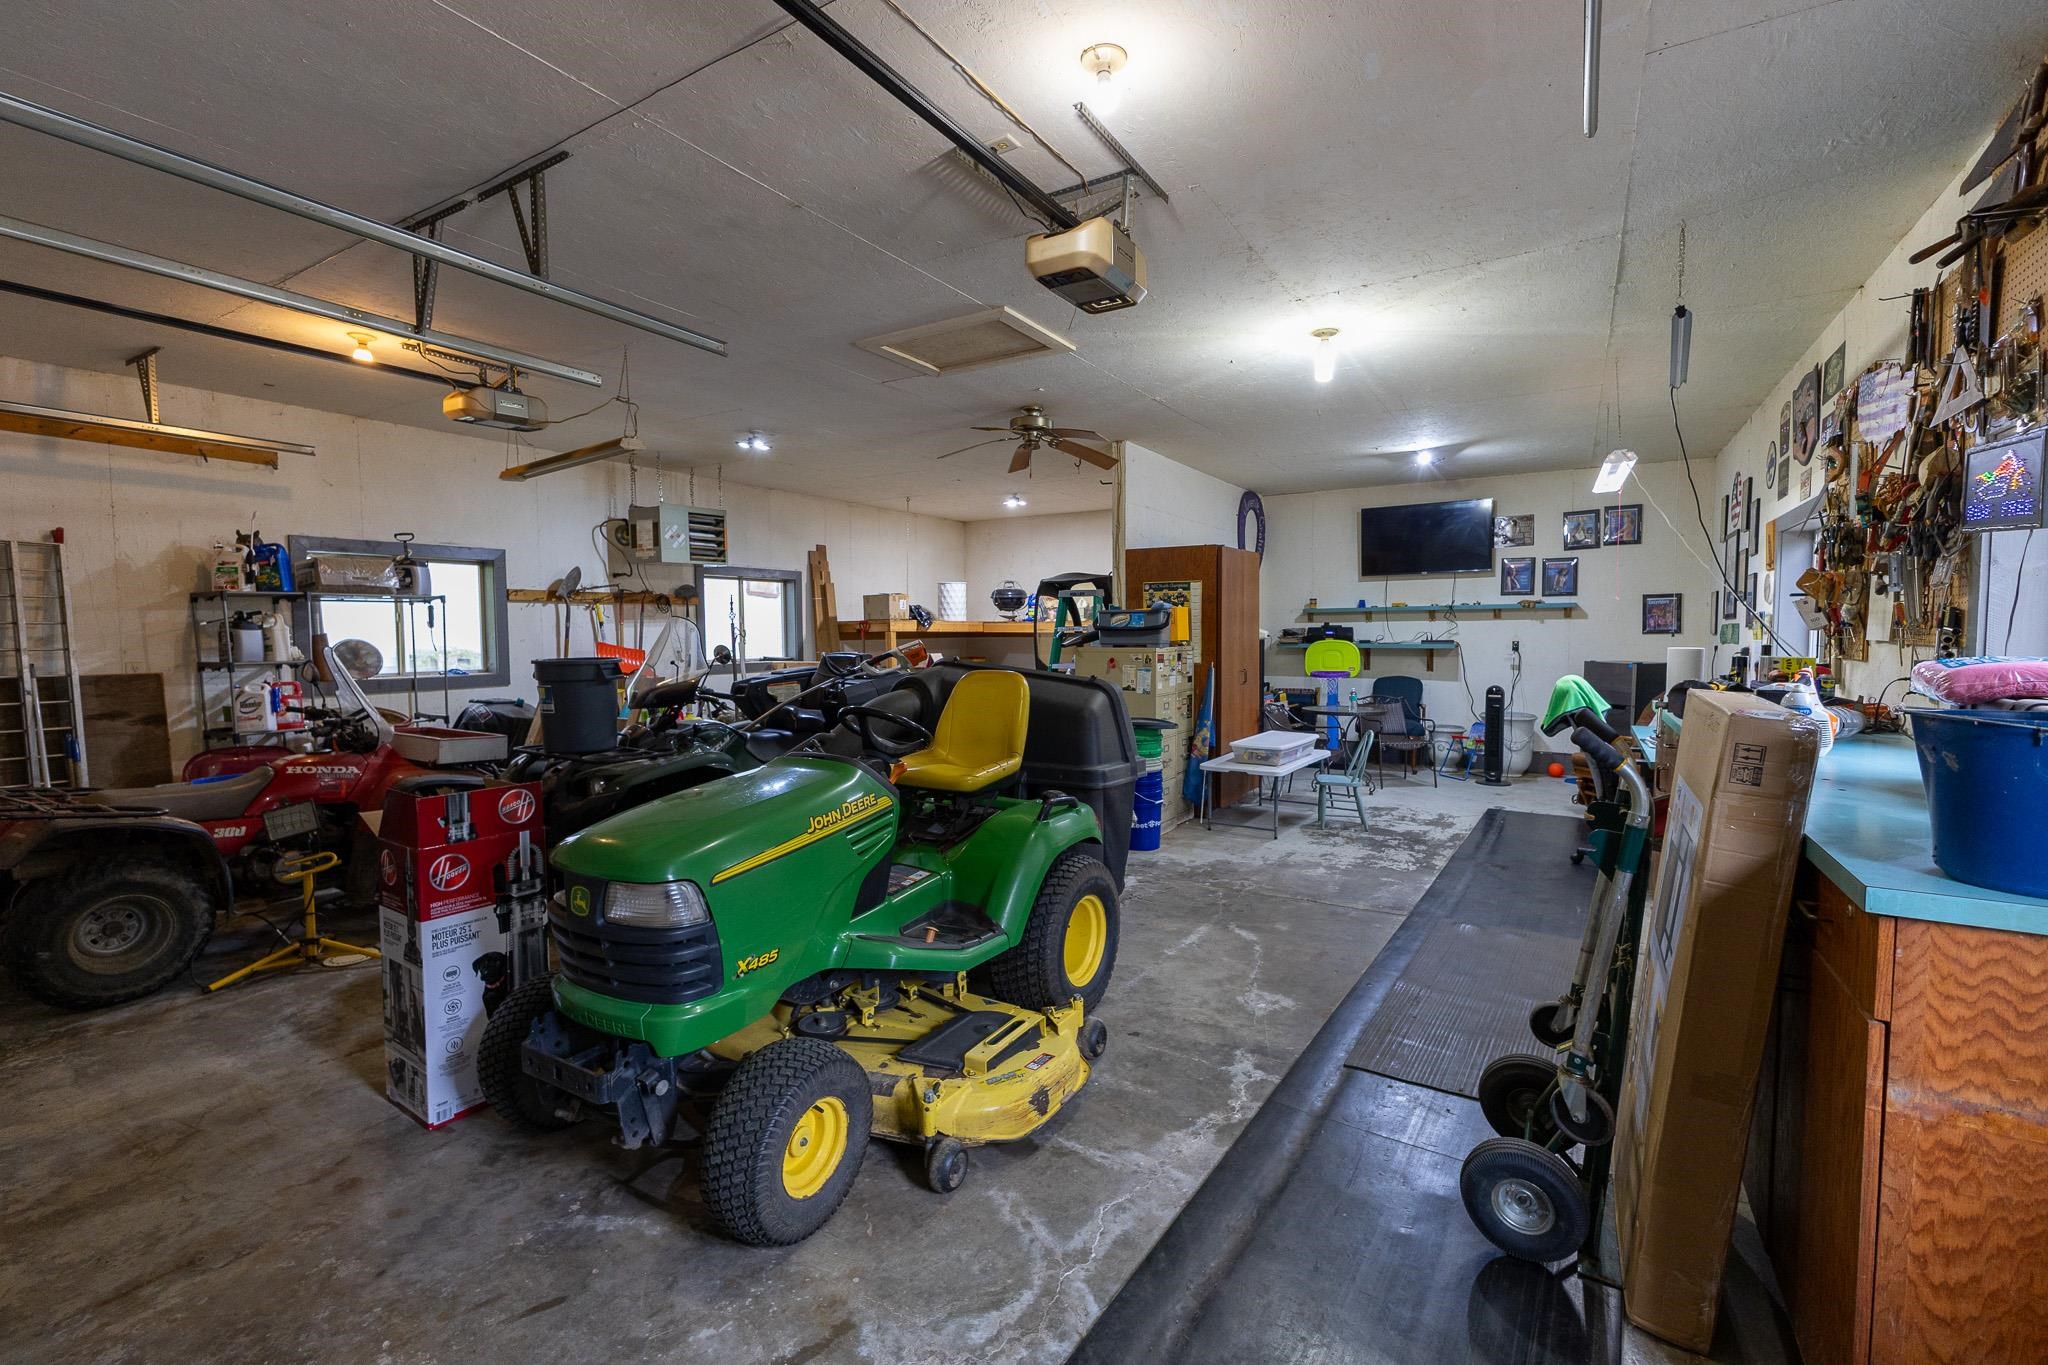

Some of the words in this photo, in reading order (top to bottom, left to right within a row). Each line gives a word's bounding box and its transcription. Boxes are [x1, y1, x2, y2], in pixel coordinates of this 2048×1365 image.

[285, 765, 361, 774] HONDA
[807, 808, 841, 833] JOHN
[841, 793, 877, 818] DEERE
[213, 826, 247, 838] 300
[431, 928, 458, 942] MOTEUR
[459, 925, 467, 935] 25
[431, 938, 449, 951] PLUS
[737, 948, 779, 976] X485
[584, 1010, 632, 1037] DEERE
